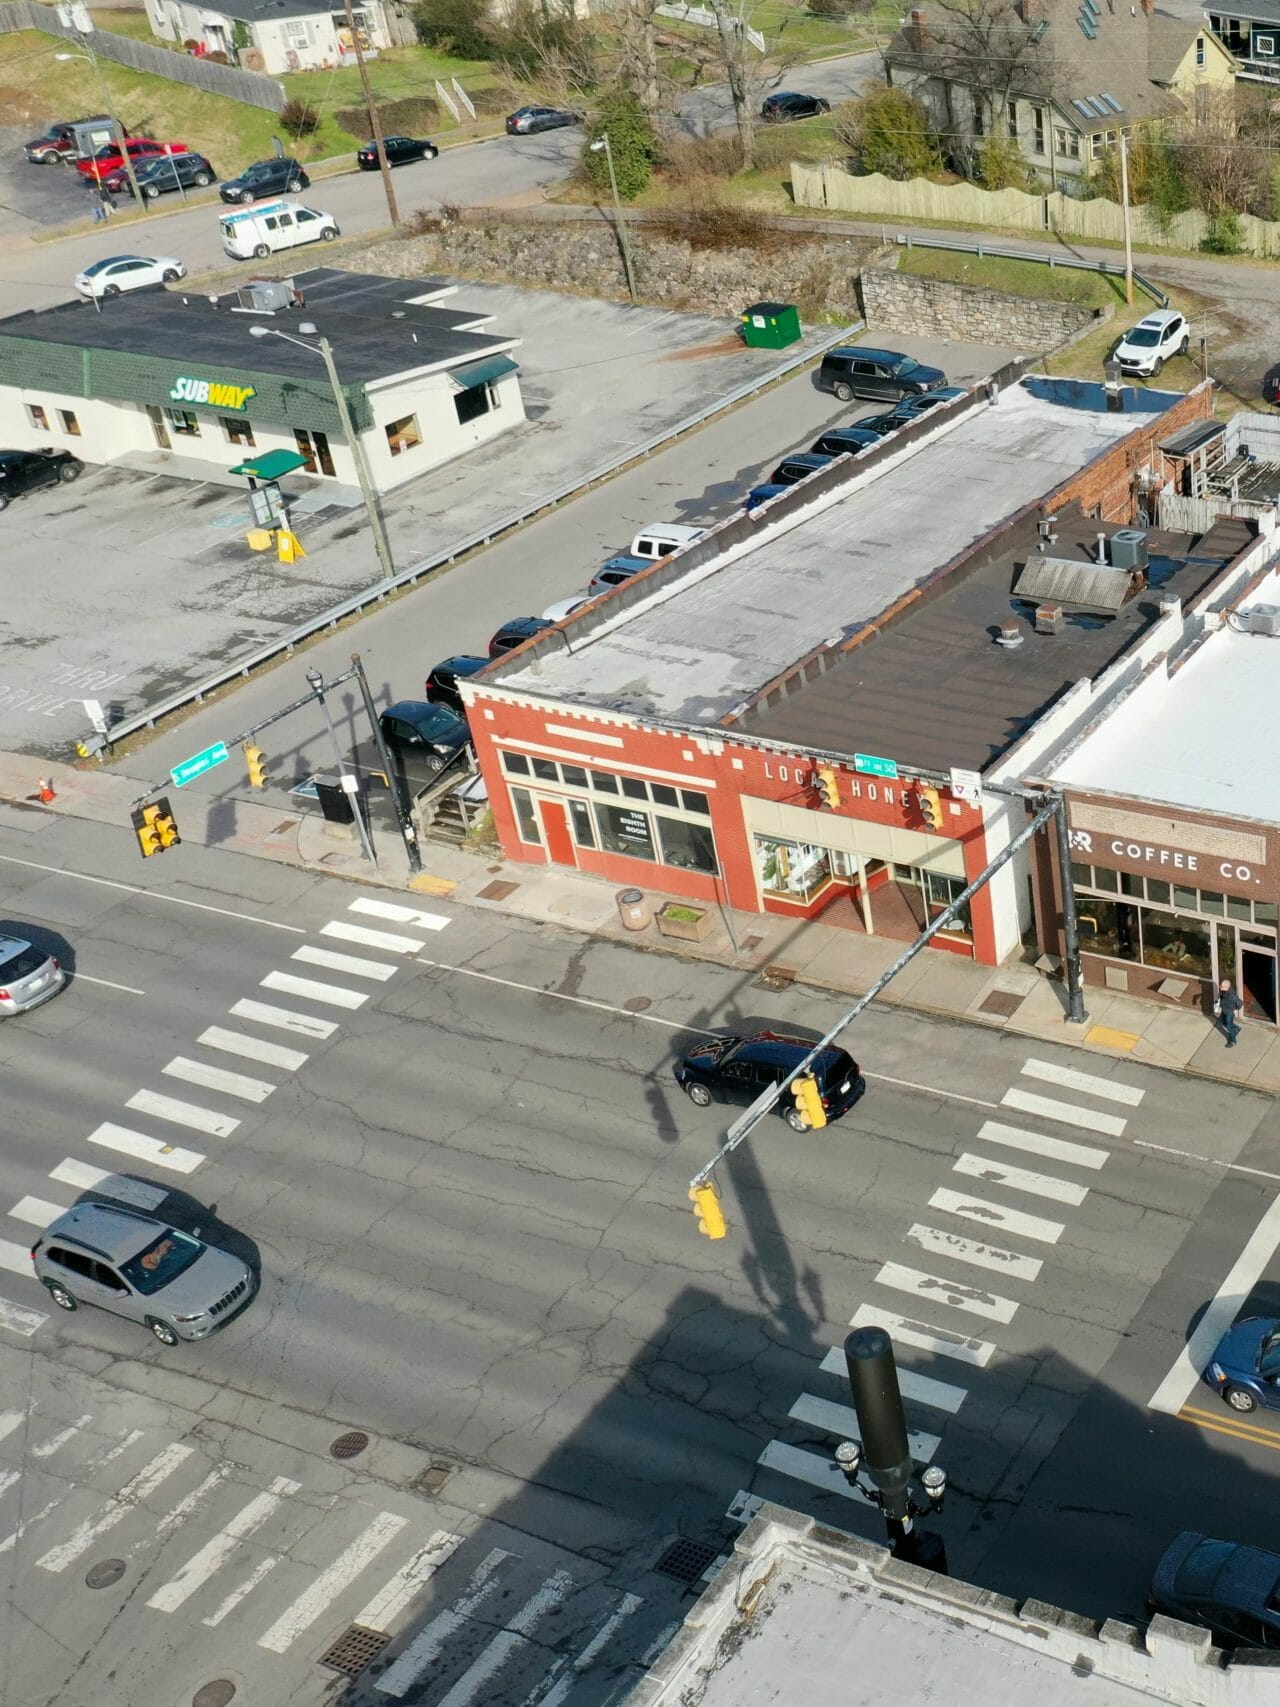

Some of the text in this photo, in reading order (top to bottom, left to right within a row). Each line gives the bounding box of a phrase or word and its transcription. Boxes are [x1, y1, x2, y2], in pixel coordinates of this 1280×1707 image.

[169, 377, 256, 410] SUBWAY
[764, 762, 820, 788] LOCA
[619, 817, 646, 829] EIGHTH
[630, 812, 645, 821] THE
[625, 826, 648, 836] ROOM
[1111, 841, 1198, 871] COFFEE
[1219, 863, 1261, 884] CO.
